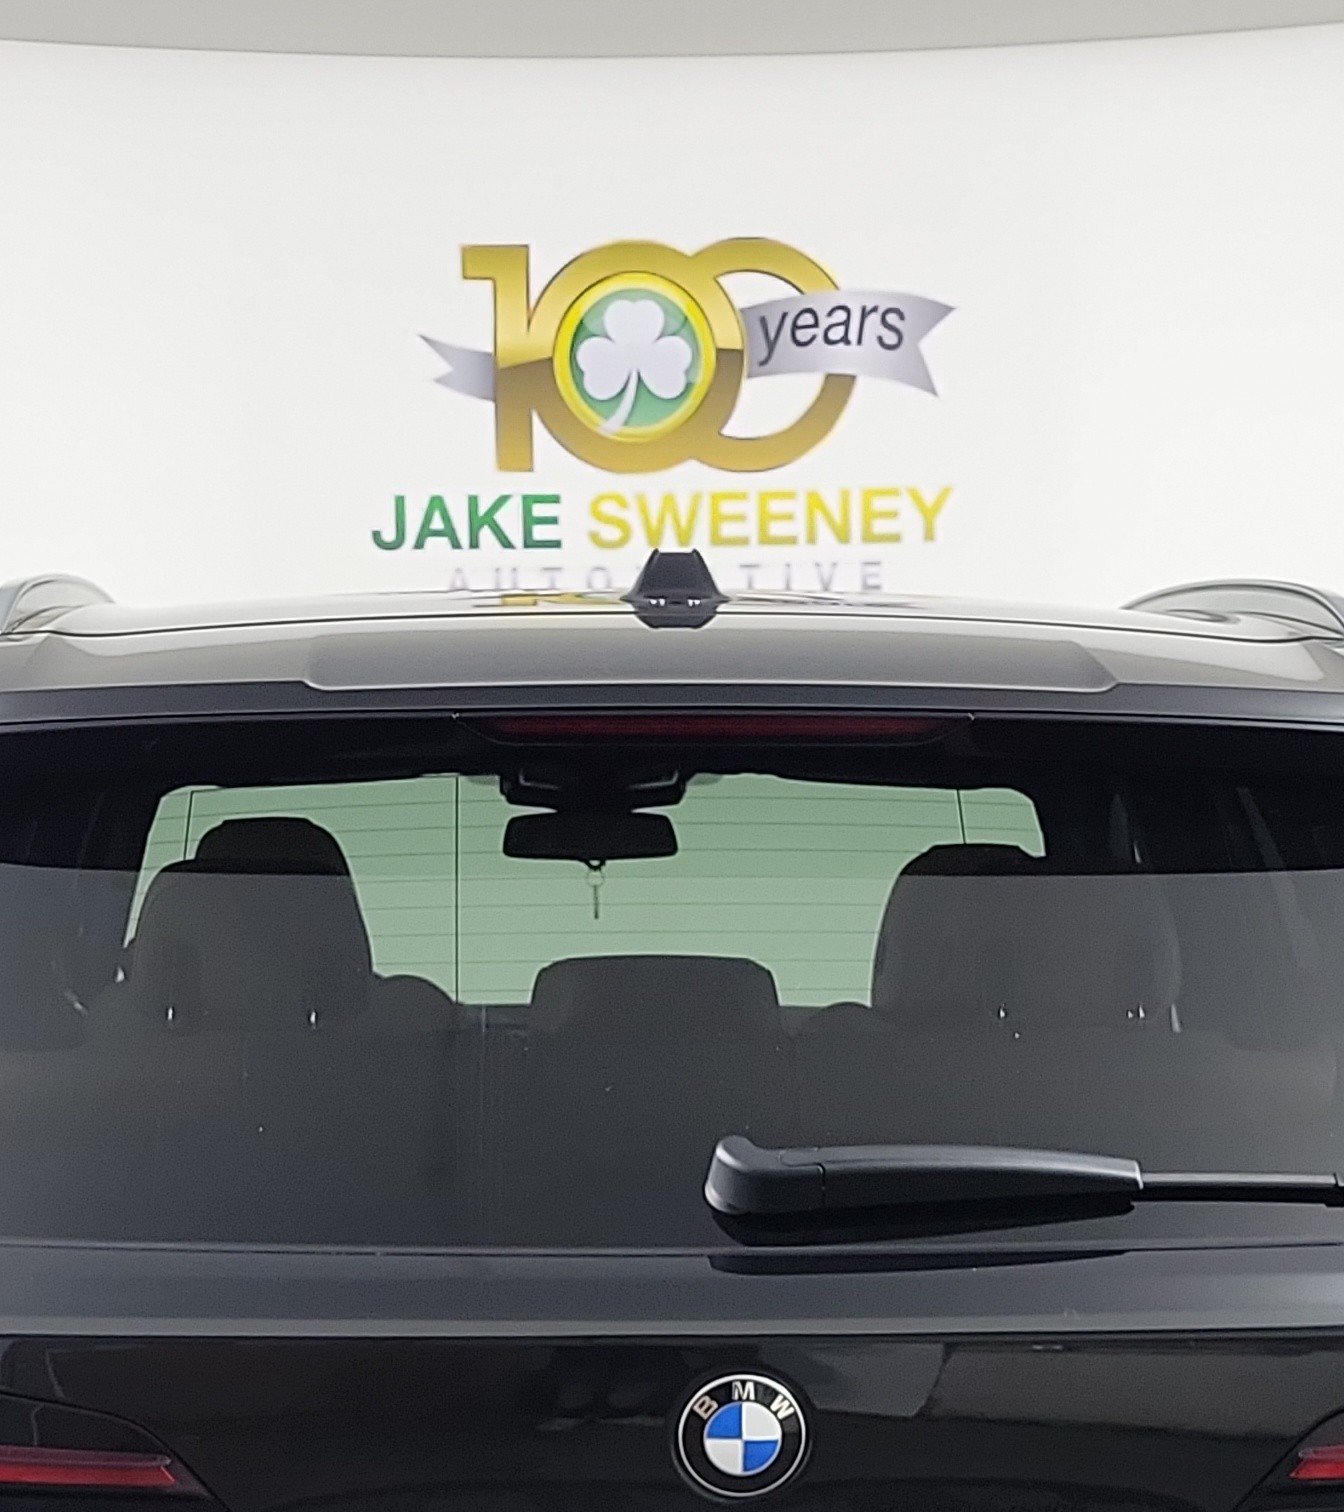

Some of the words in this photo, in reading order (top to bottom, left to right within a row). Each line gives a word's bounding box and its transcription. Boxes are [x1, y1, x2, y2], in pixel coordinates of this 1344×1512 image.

[460, 237, 856, 474] 100
[759, 304, 906, 366] years
[371, 494, 562, 551] JAKE
[587, 486, 953, 548] SWEENEY
[448, 561, 884, 592] AUTOTIVE
[692, 1381, 795, 1420] BMW
